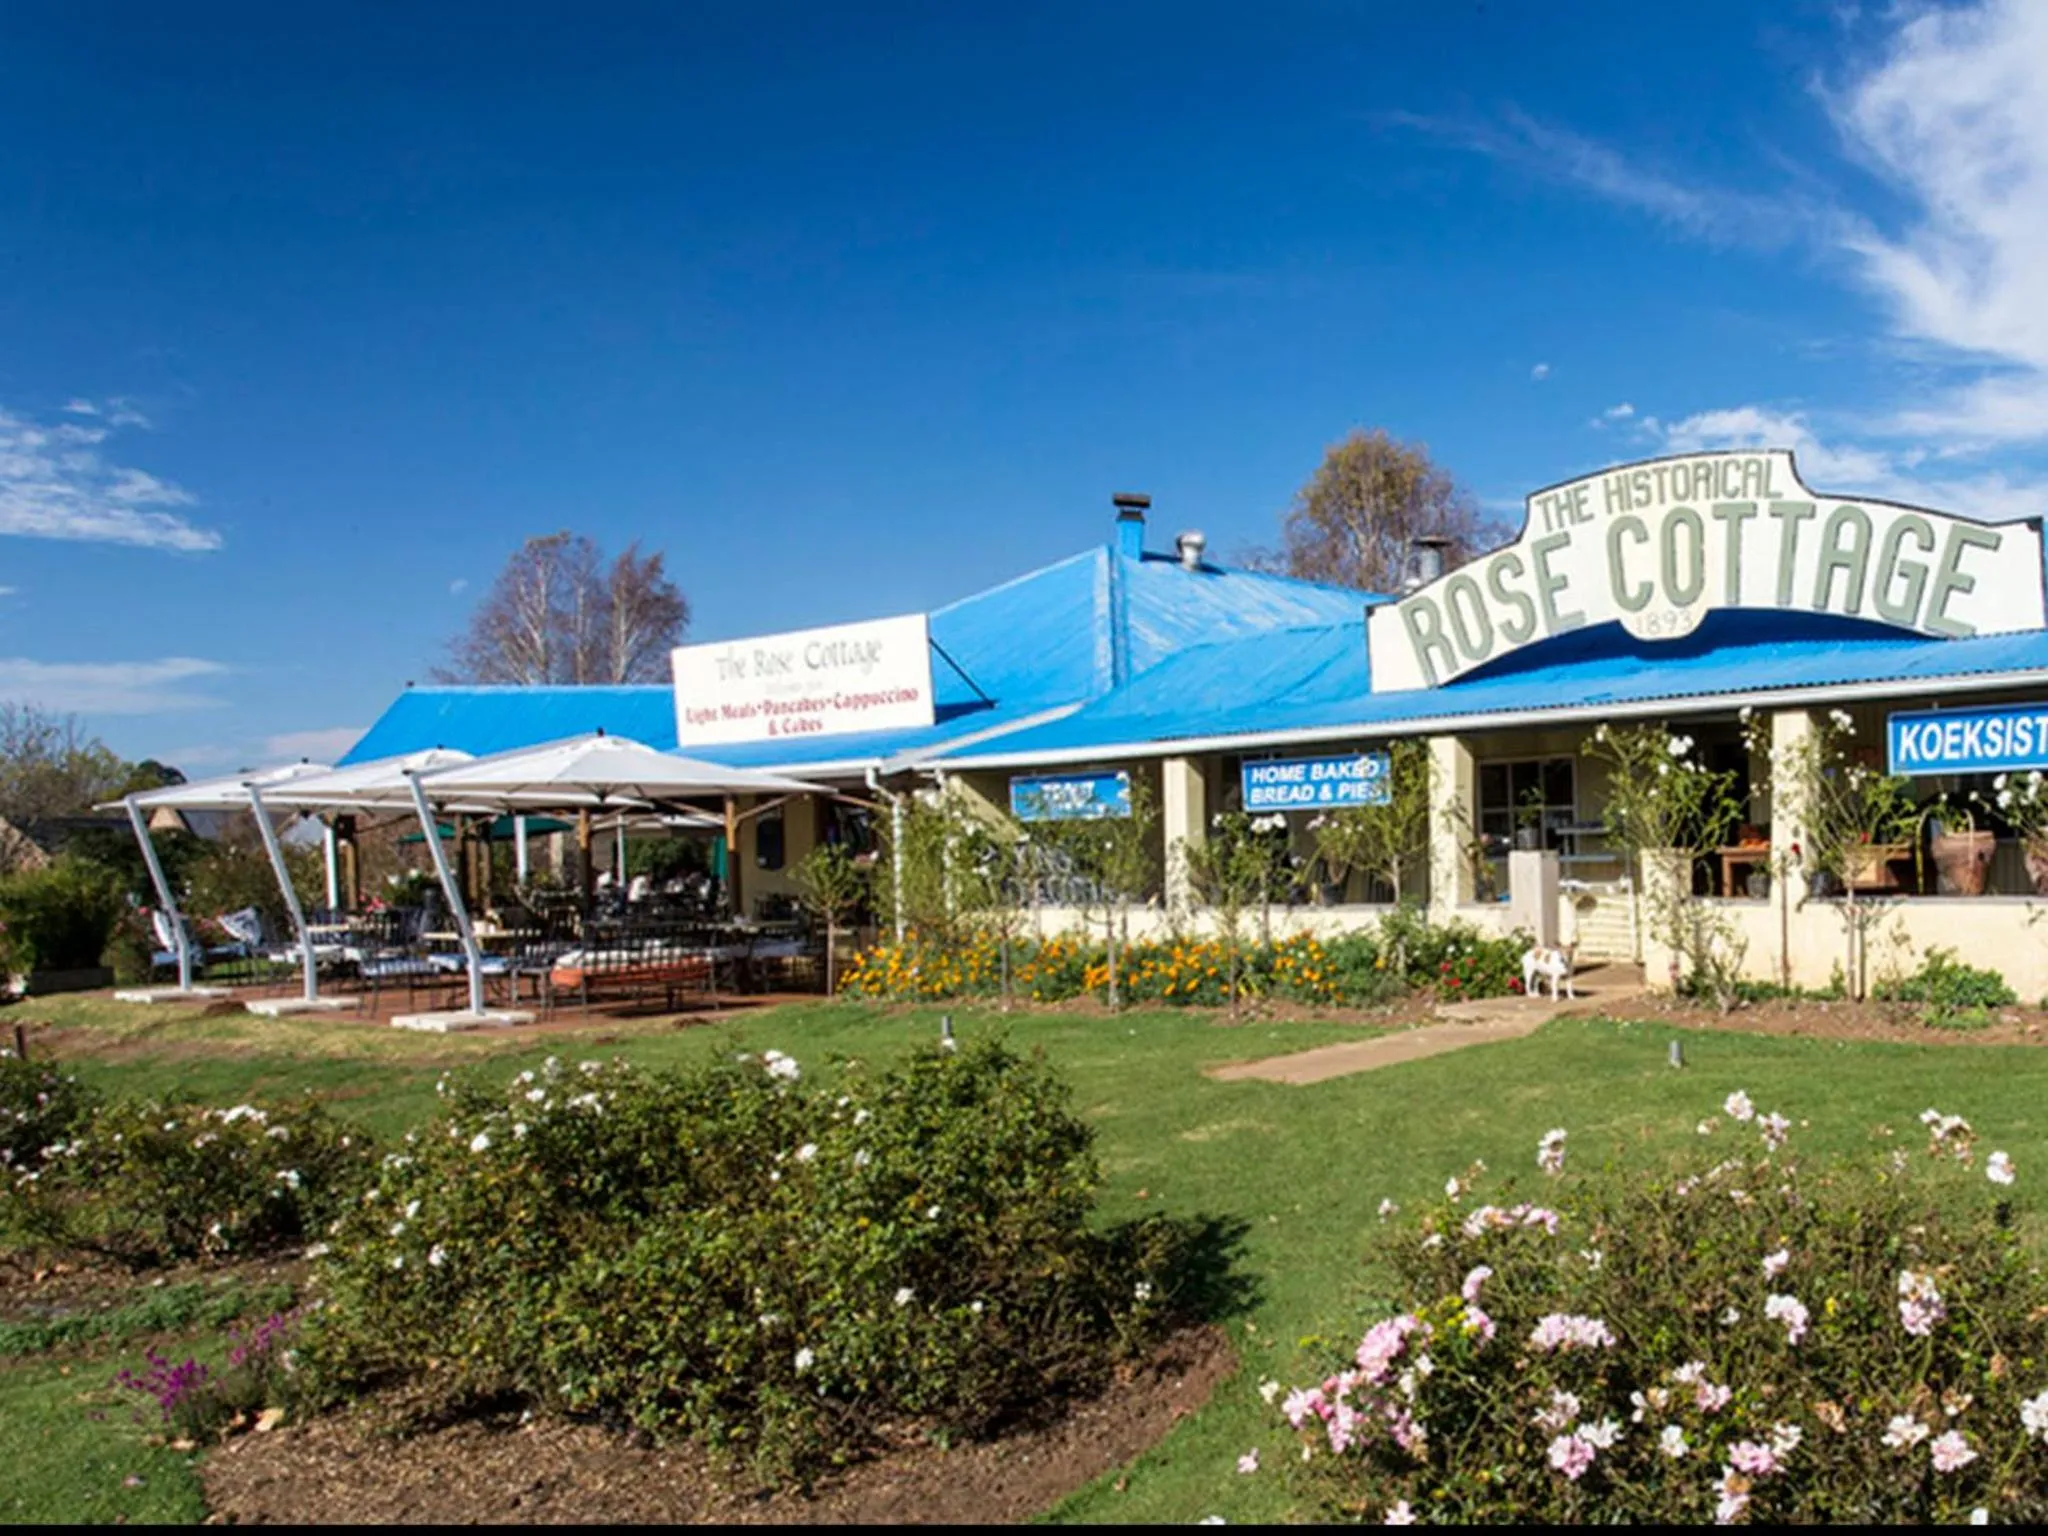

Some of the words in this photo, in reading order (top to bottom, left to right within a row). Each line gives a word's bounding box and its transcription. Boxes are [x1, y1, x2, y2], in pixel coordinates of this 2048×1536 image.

[1536, 480, 1594, 532] THE
[1603, 457, 1783, 517] HISTORICAL
[1398, 532, 1587, 689] ROSE
[1605, 501, 2002, 640] COTTAGE
[715, 648, 747, 682] The
[753, 648, 795, 677] Rose
[805, 639, 883, 676] Cottage
[685, 704, 718, 726] Light
[783, 717, 824, 735] Cakes
[1251, 764, 1306, 783] HOME
[1310, 759, 1380, 781] BAKED
[1250, 784, 1315, 804] BREAD
[1317, 782, 1333, 801] &
[1337, 780, 1382, 800] PIES
